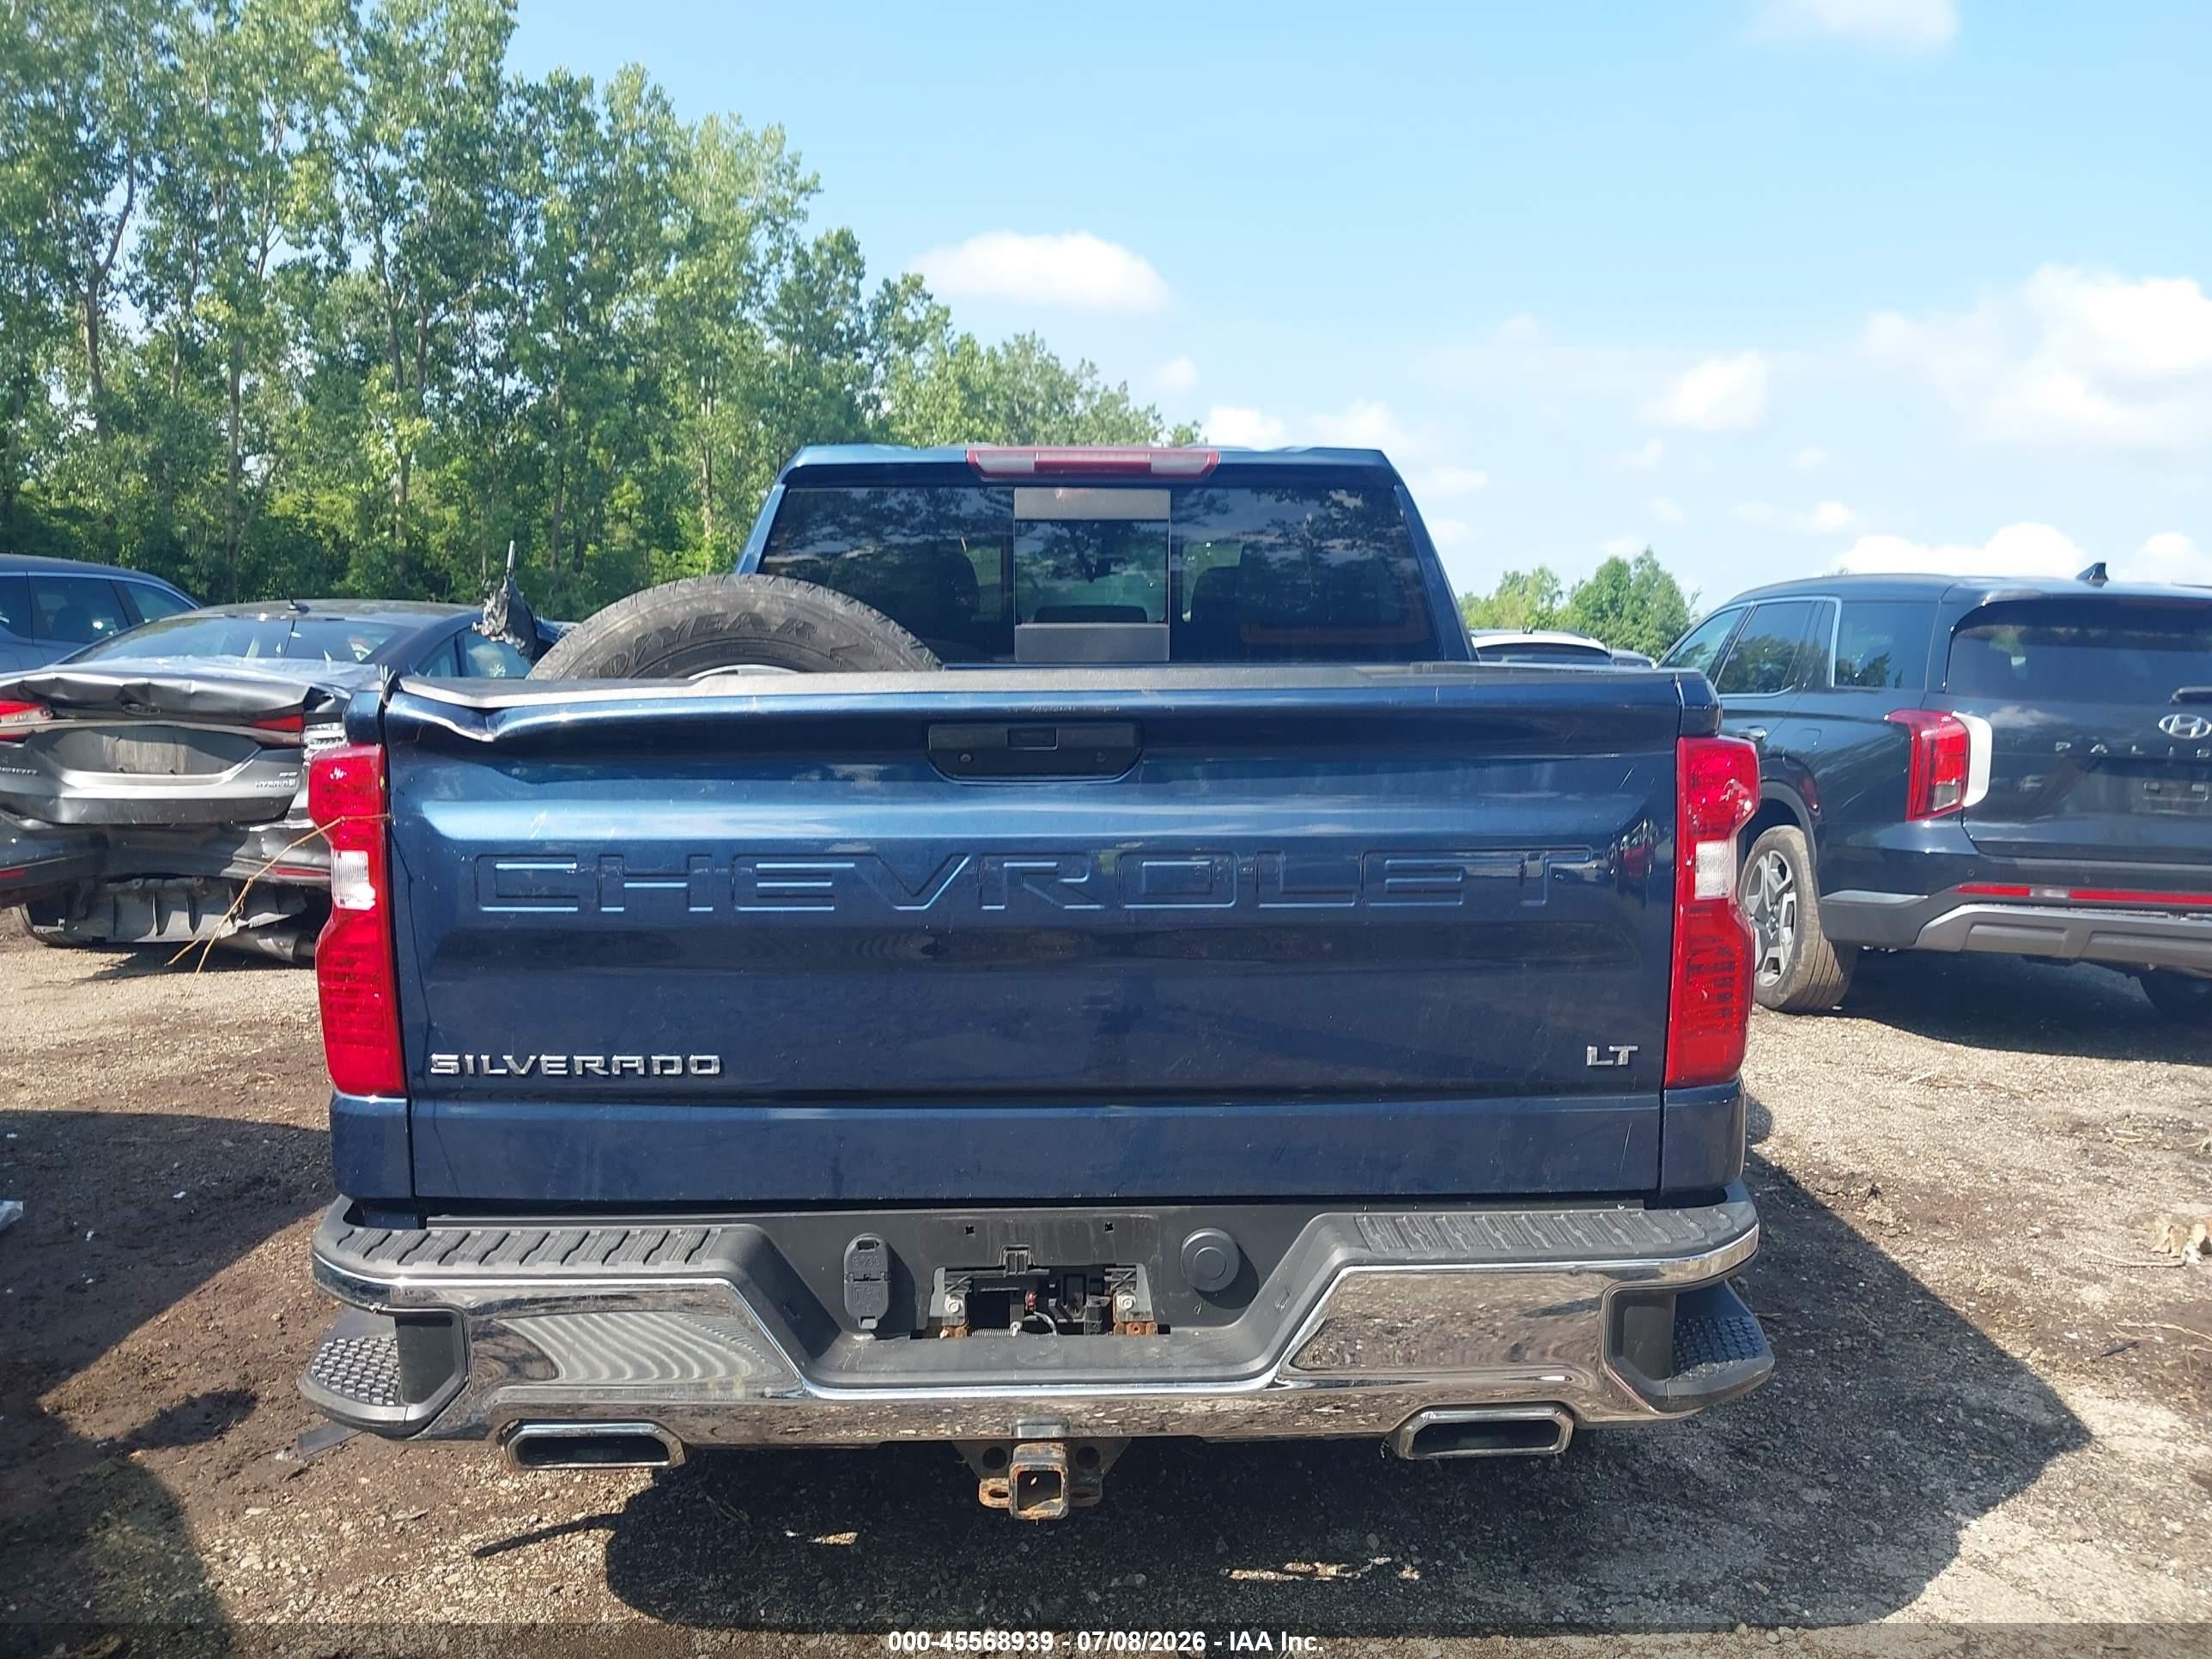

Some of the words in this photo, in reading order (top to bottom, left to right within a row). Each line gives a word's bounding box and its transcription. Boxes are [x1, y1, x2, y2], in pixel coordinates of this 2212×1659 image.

[475, 847, 1593, 913] CHEVROLET
[429, 1053, 723, 1076] SILVERADO
[1586, 1045, 1639, 1066] LT
